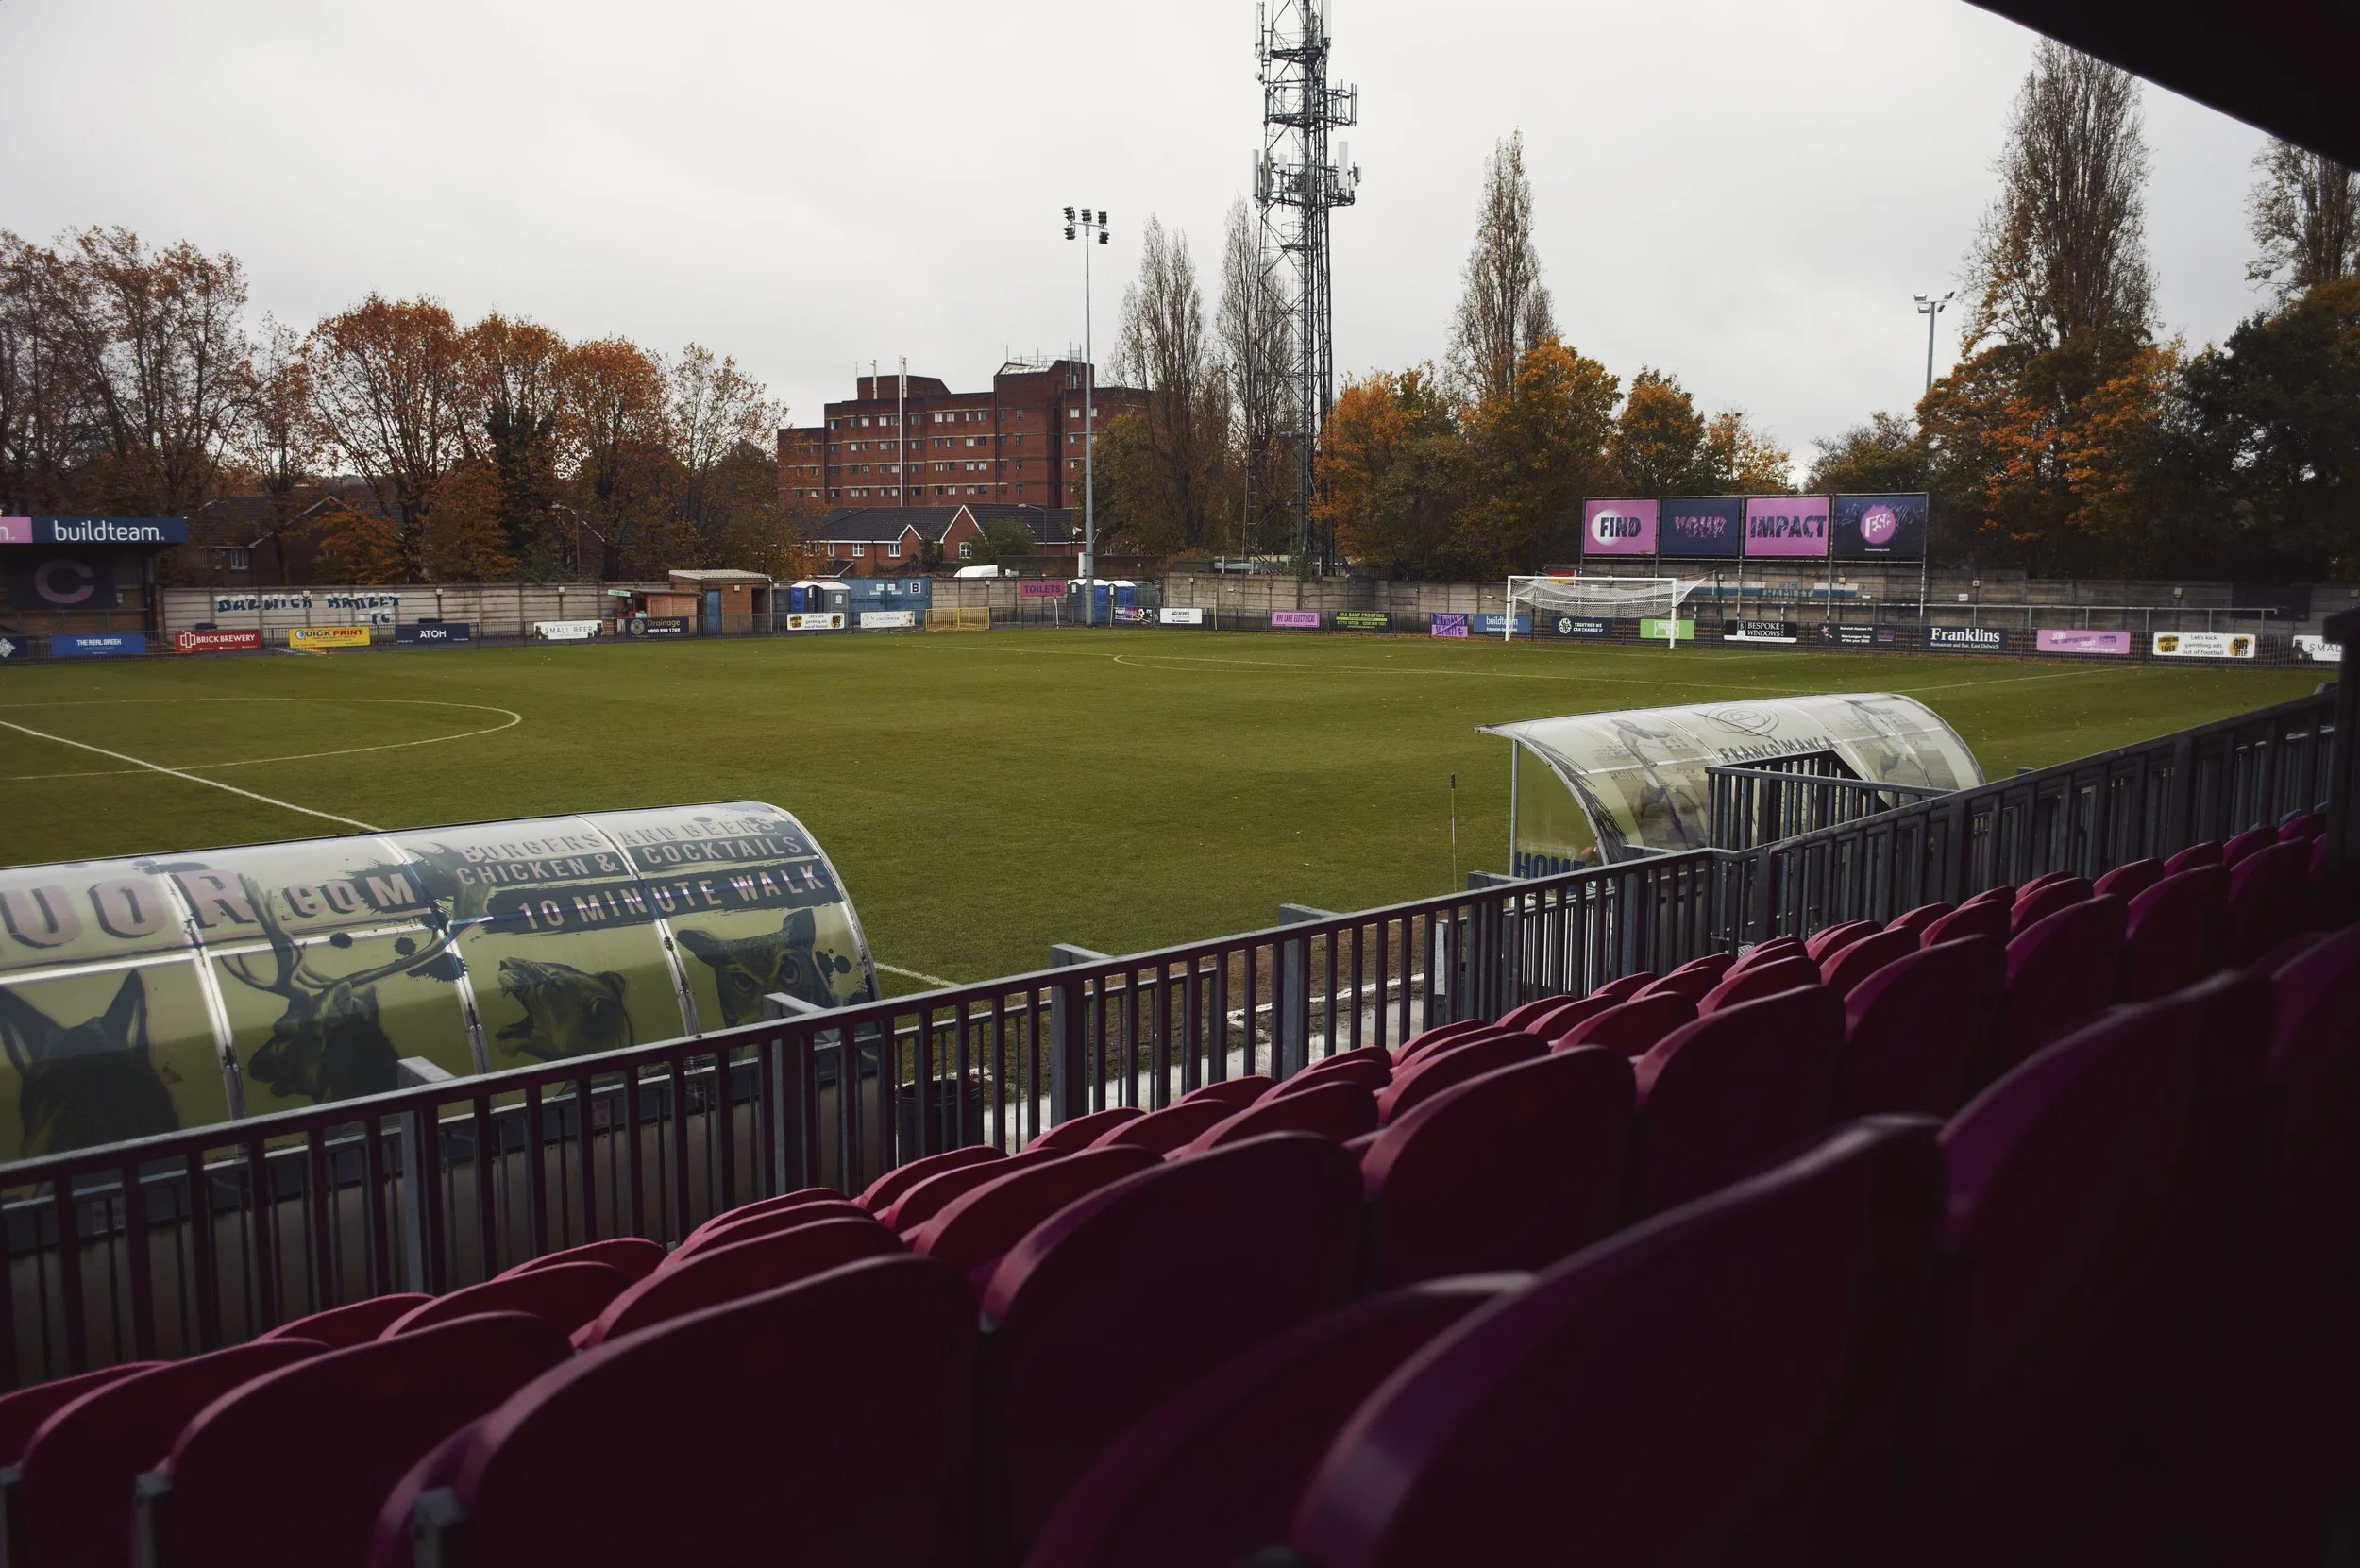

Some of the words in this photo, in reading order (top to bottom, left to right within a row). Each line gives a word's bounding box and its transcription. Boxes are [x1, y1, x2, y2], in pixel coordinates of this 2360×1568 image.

[1599, 516, 1642, 538] FIND
[1673, 515, 1727, 538] YOUR
[1750, 515, 1828, 538] IMPACT
[912, 583, 919, 593] B
[1486, 615, 1519, 625] buildtem
[196, 635, 220, 644] BRICK
[220, 633, 256, 643] BREWERY
[419, 630, 447, 638] ATOM
[1930, 627, 2000, 642] Franklins
[2233, 639, 2249, 650] BIG
[2309, 643, 2341, 652] SMAL
[1718, 742, 1782, 763] FRANCO
[1779, 735, 1839, 755] MANCA
[459, 832, 607, 864] BURGERS
[617, 826, 679, 847] AND
[683, 816, 778, 839] BEERS
[455, 862, 590, 886] CHICKEN
[594, 851, 620, 874] &
[640, 836, 803, 865] COCKTAILS
[518, 899, 565, 930] 10
[572, 877, 723, 925] MINUTE
[727, 864, 827, 902] WALK
